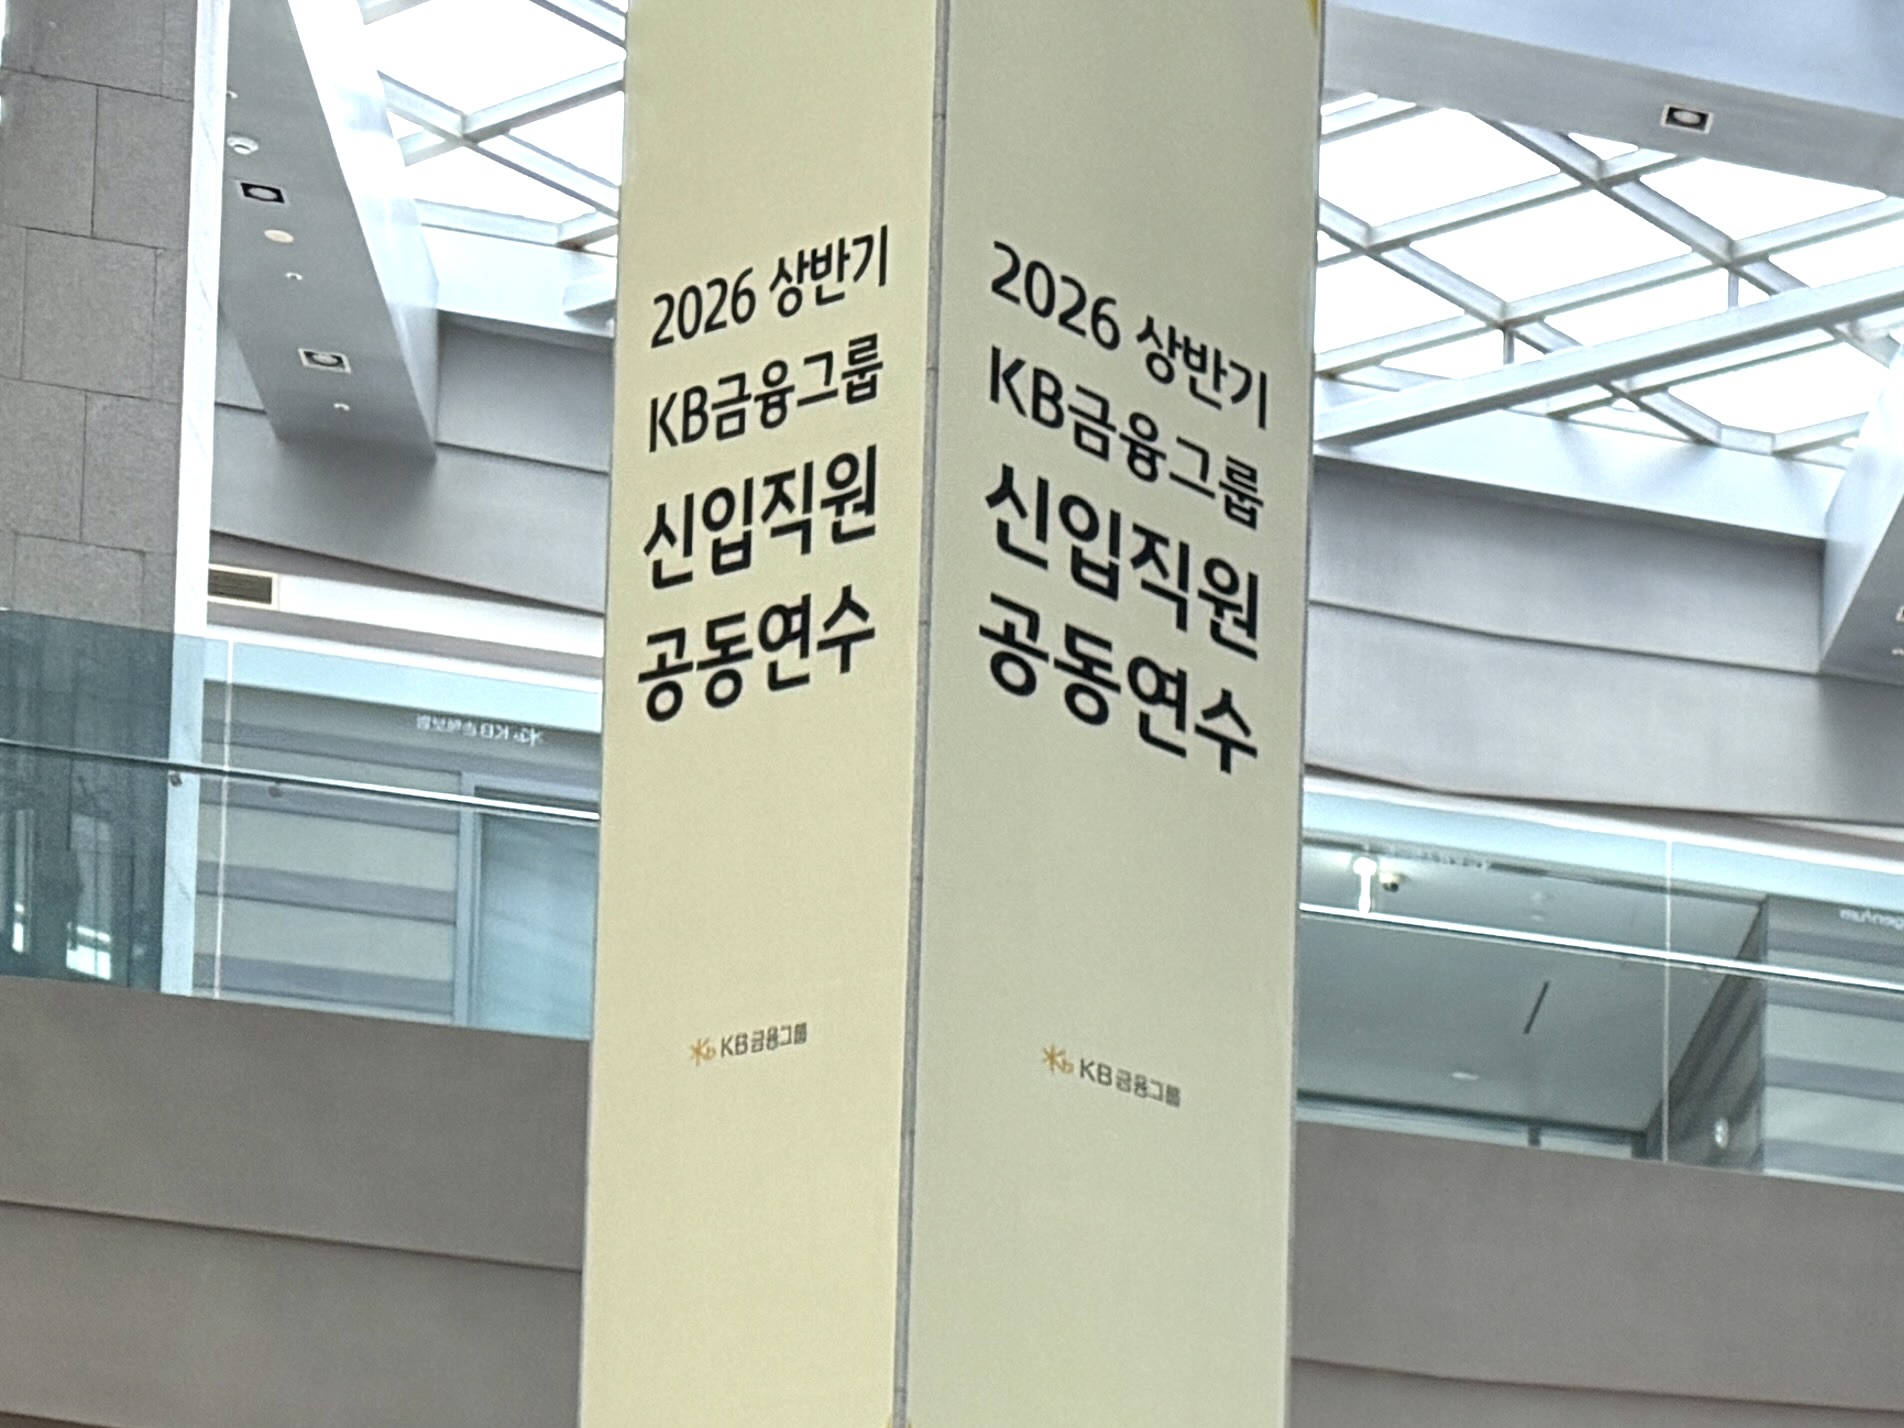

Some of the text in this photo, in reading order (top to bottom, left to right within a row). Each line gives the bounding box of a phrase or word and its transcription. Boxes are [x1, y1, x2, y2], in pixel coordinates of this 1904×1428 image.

[651, 224, 888, 349] 2026 상반기
[991, 240, 1268, 430] 2026 상반기
[649, 332, 884, 453] KB금융그룹
[989, 344, 1265, 531] KB금융그룹
[643, 444, 878, 591] 신입직원
[985, 463, 1259, 660] 신입직원
[637, 584, 875, 722] 공동연수
[978, 591, 1258, 775] 공동연수
